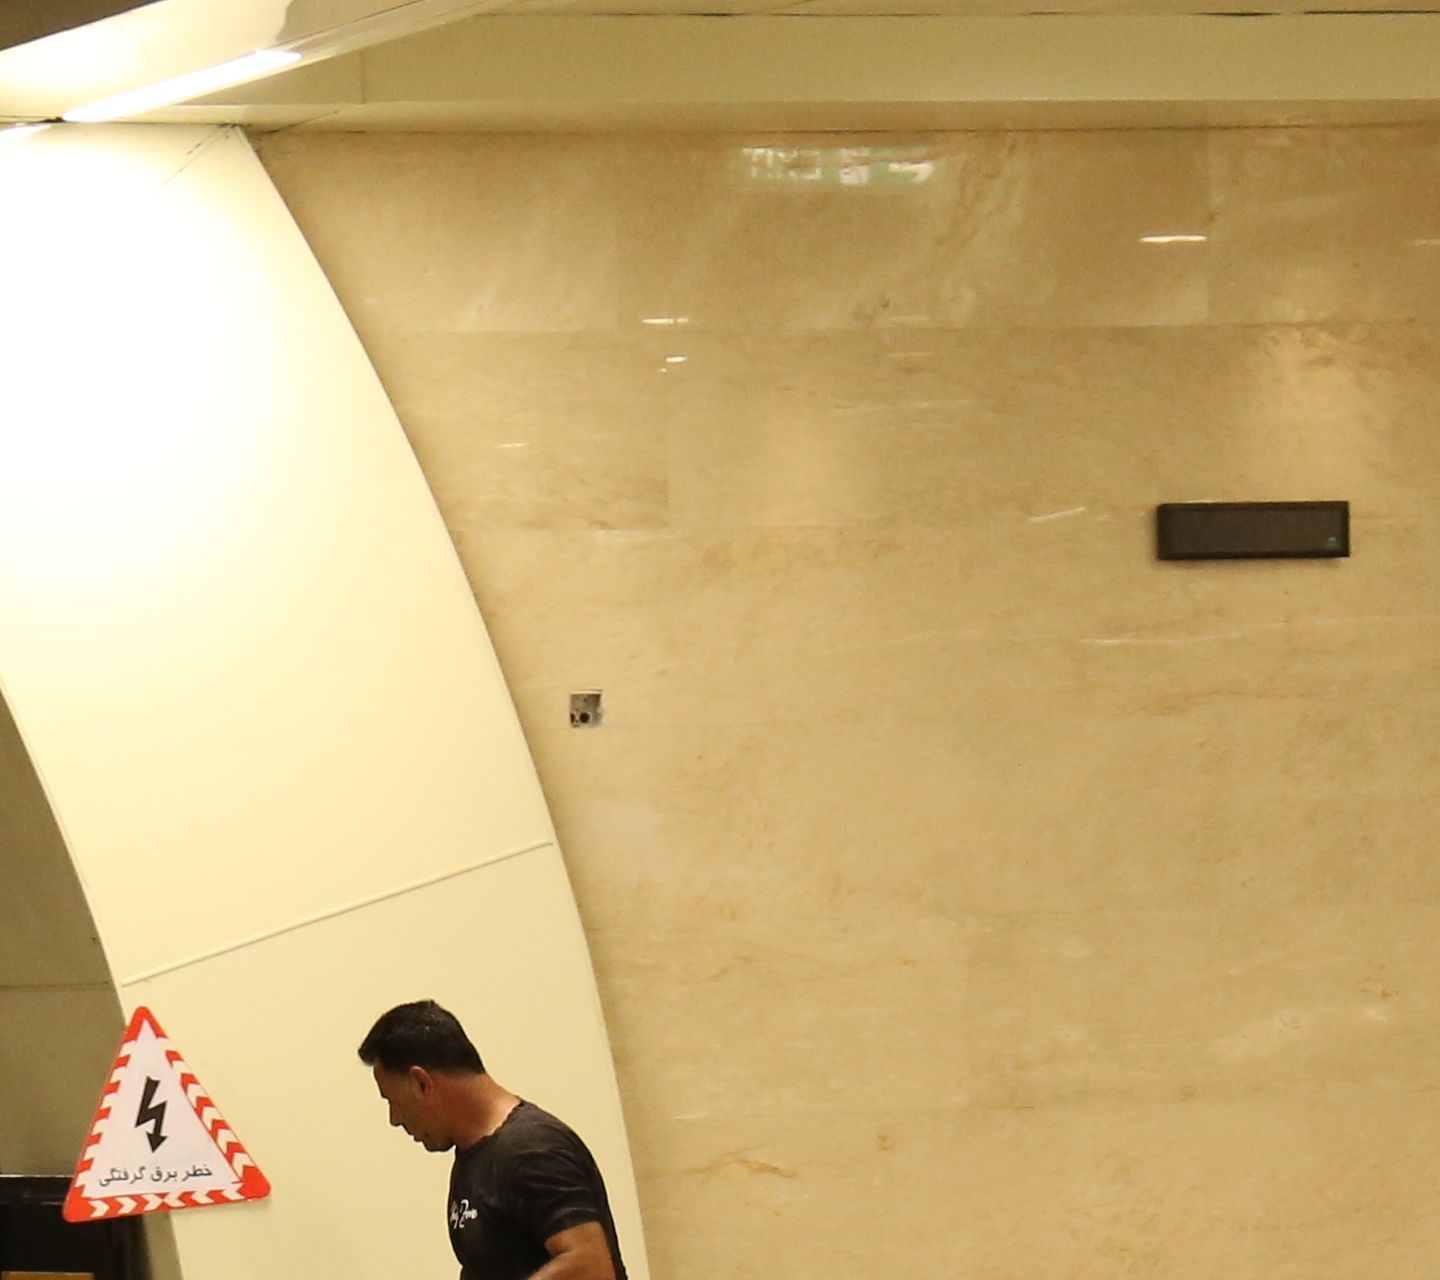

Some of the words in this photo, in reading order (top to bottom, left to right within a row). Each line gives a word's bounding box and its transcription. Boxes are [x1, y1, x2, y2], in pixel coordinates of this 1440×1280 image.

[99, 1166, 146, 1187] گرفتگی
[151, 1166, 178, 1183] برق
[182, 1163, 213, 1182] خطر
